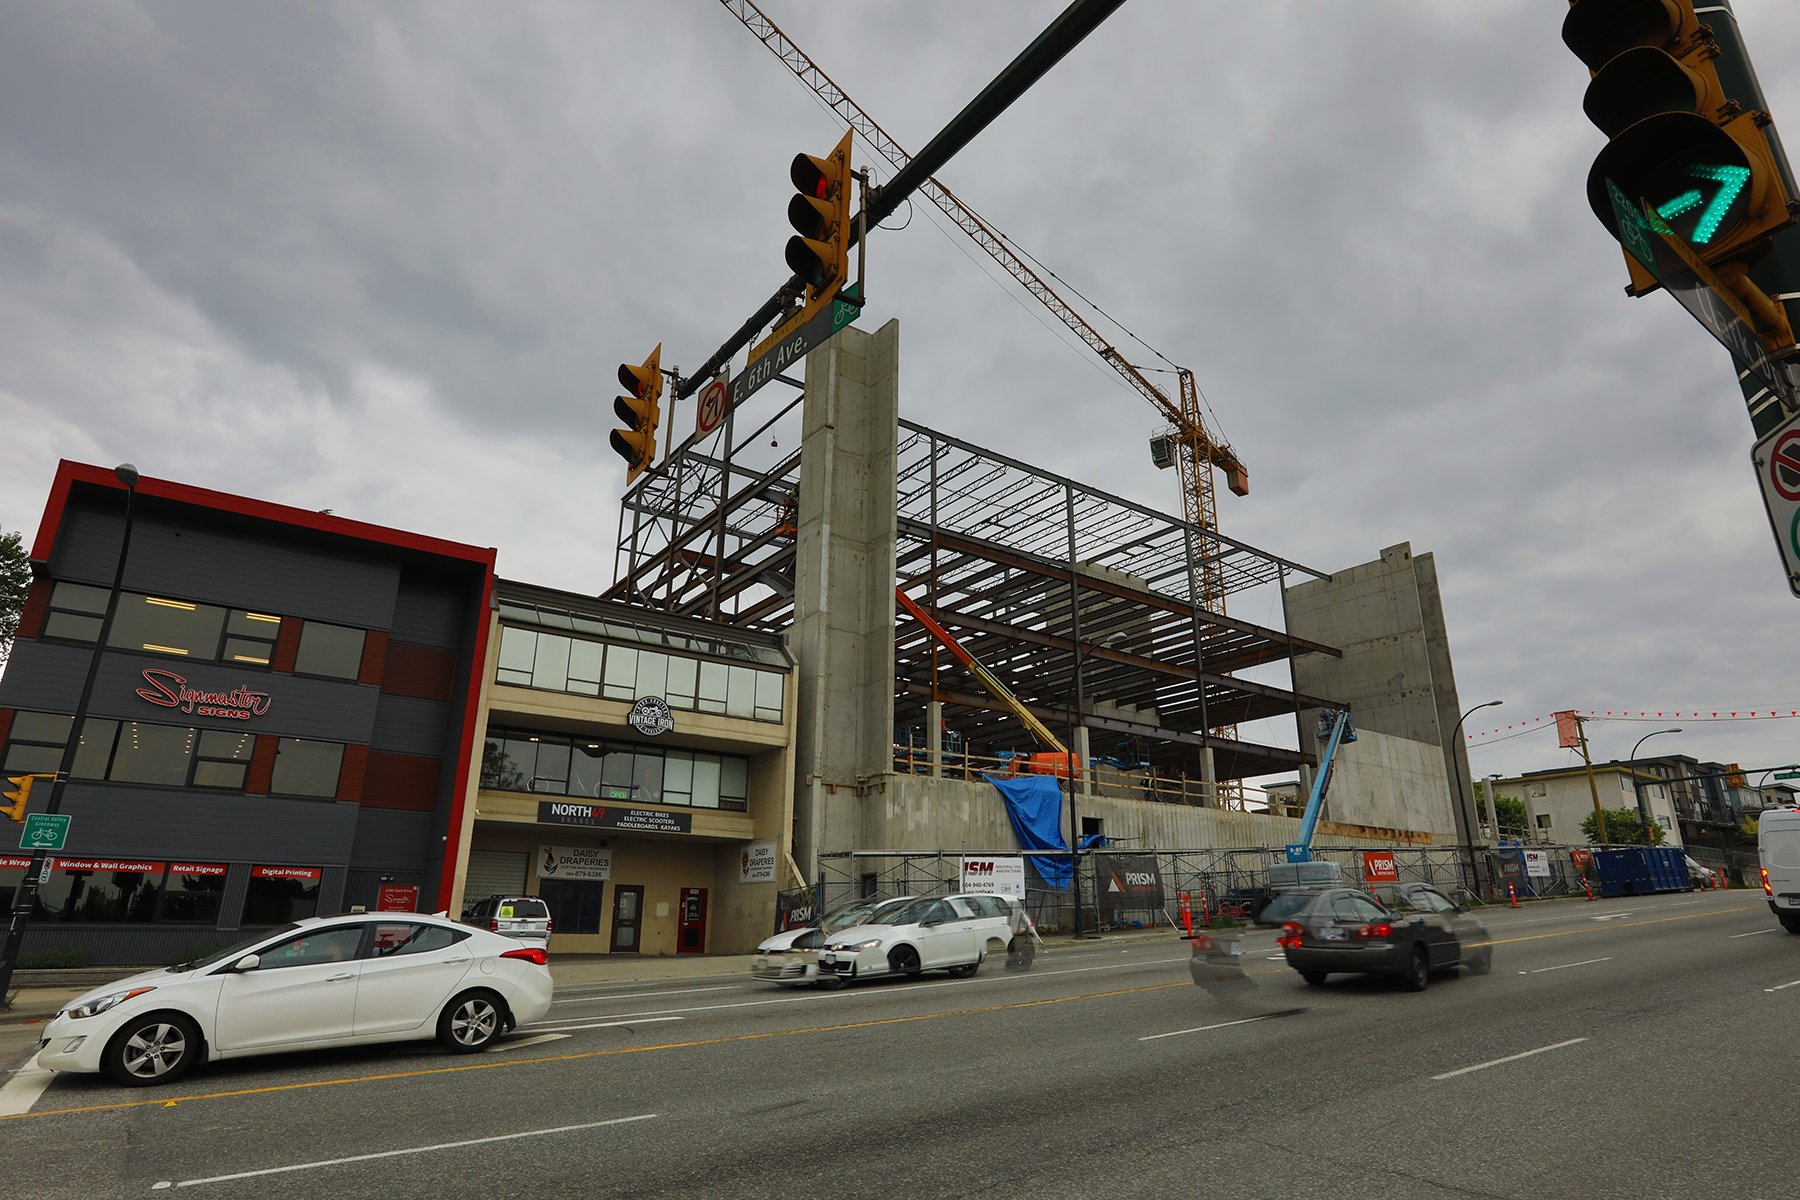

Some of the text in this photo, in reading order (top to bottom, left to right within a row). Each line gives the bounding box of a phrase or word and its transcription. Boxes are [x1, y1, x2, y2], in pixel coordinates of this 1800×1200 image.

[1695, 281, 1754, 363] Clark
[732, 337, 808, 403] E. 6th Ave.
[136, 669, 271, 715] Signmaster
[197, 706, 250, 719] SIGNS
[629, 713, 657, 726] VINTAGE
[658, 717, 674, 731] IRON
[609, 791, 627, 799] OPEN
[630, 810, 654, 818] ELECTRIC
[560, 817, 595, 825] BRANDS
[623, 816, 648, 824] ELECTRIC
[617, 821, 681, 832] PADDLEBOARDS KAYAKS
[573, 849, 600, 858] DAISY
[755, 848, 769, 857] DAISY
[9, 859, 32, 867] Wrap
[59, 860, 92, 869] Window
[99, 862, 118, 870] Wall
[118, 863, 152, 872] Graphics
[559, 856, 609, 867] DRAPERIES
[750, 857, 774, 867] DRAPERIES
[1374, 859, 1394, 871] PRISM
[195, 865, 224, 874] Signage
[262, 868, 284, 876] Digital
[964, 862, 994, 875] ISM
[1125, 872, 1156, 885] PRISM
